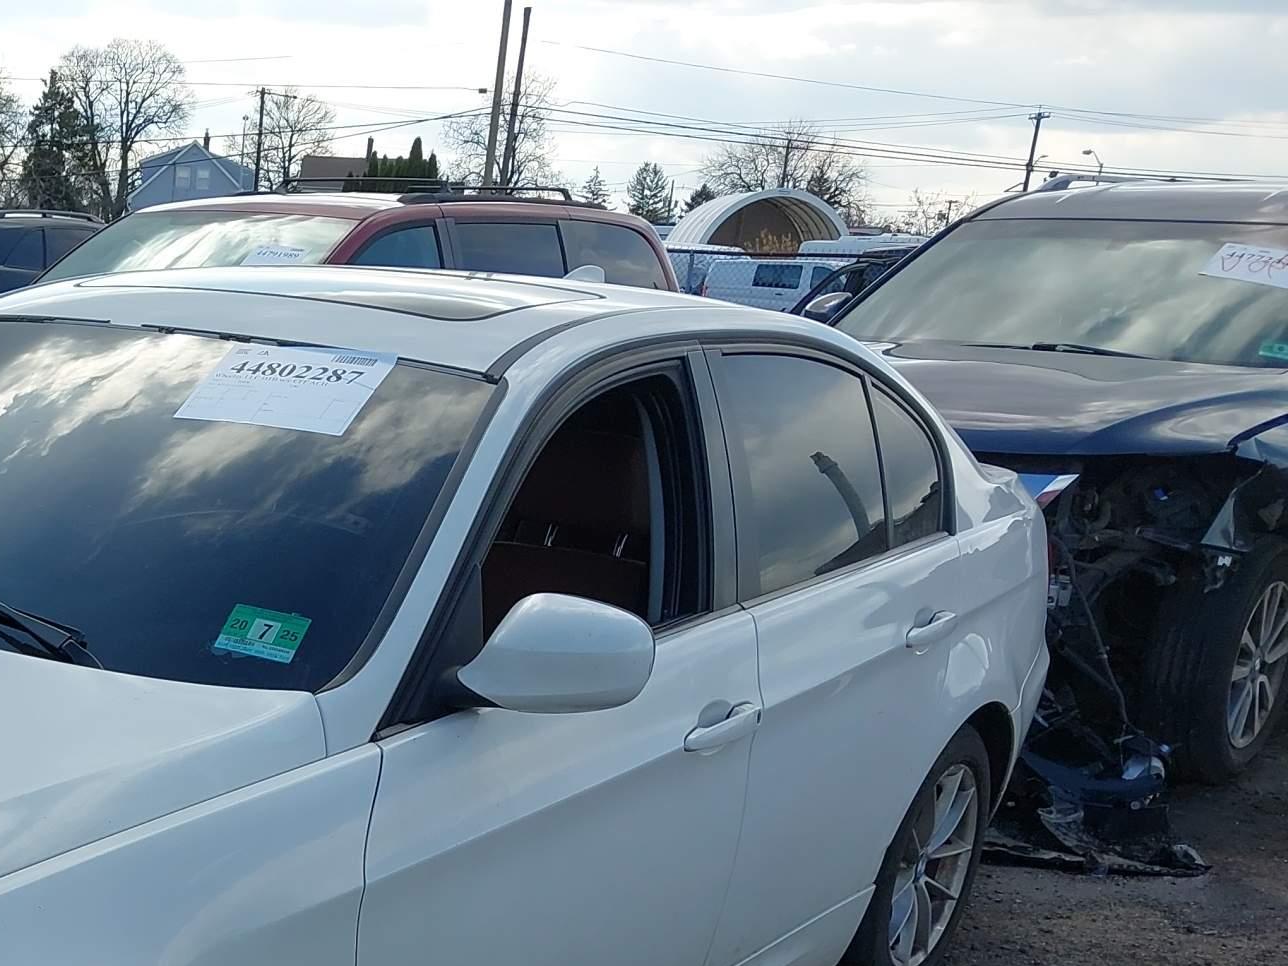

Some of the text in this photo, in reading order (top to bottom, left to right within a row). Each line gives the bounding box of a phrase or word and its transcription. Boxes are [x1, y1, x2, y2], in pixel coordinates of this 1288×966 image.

[230, 360, 367, 385] 44802287
[230, 619, 298, 641] 20 7 25
